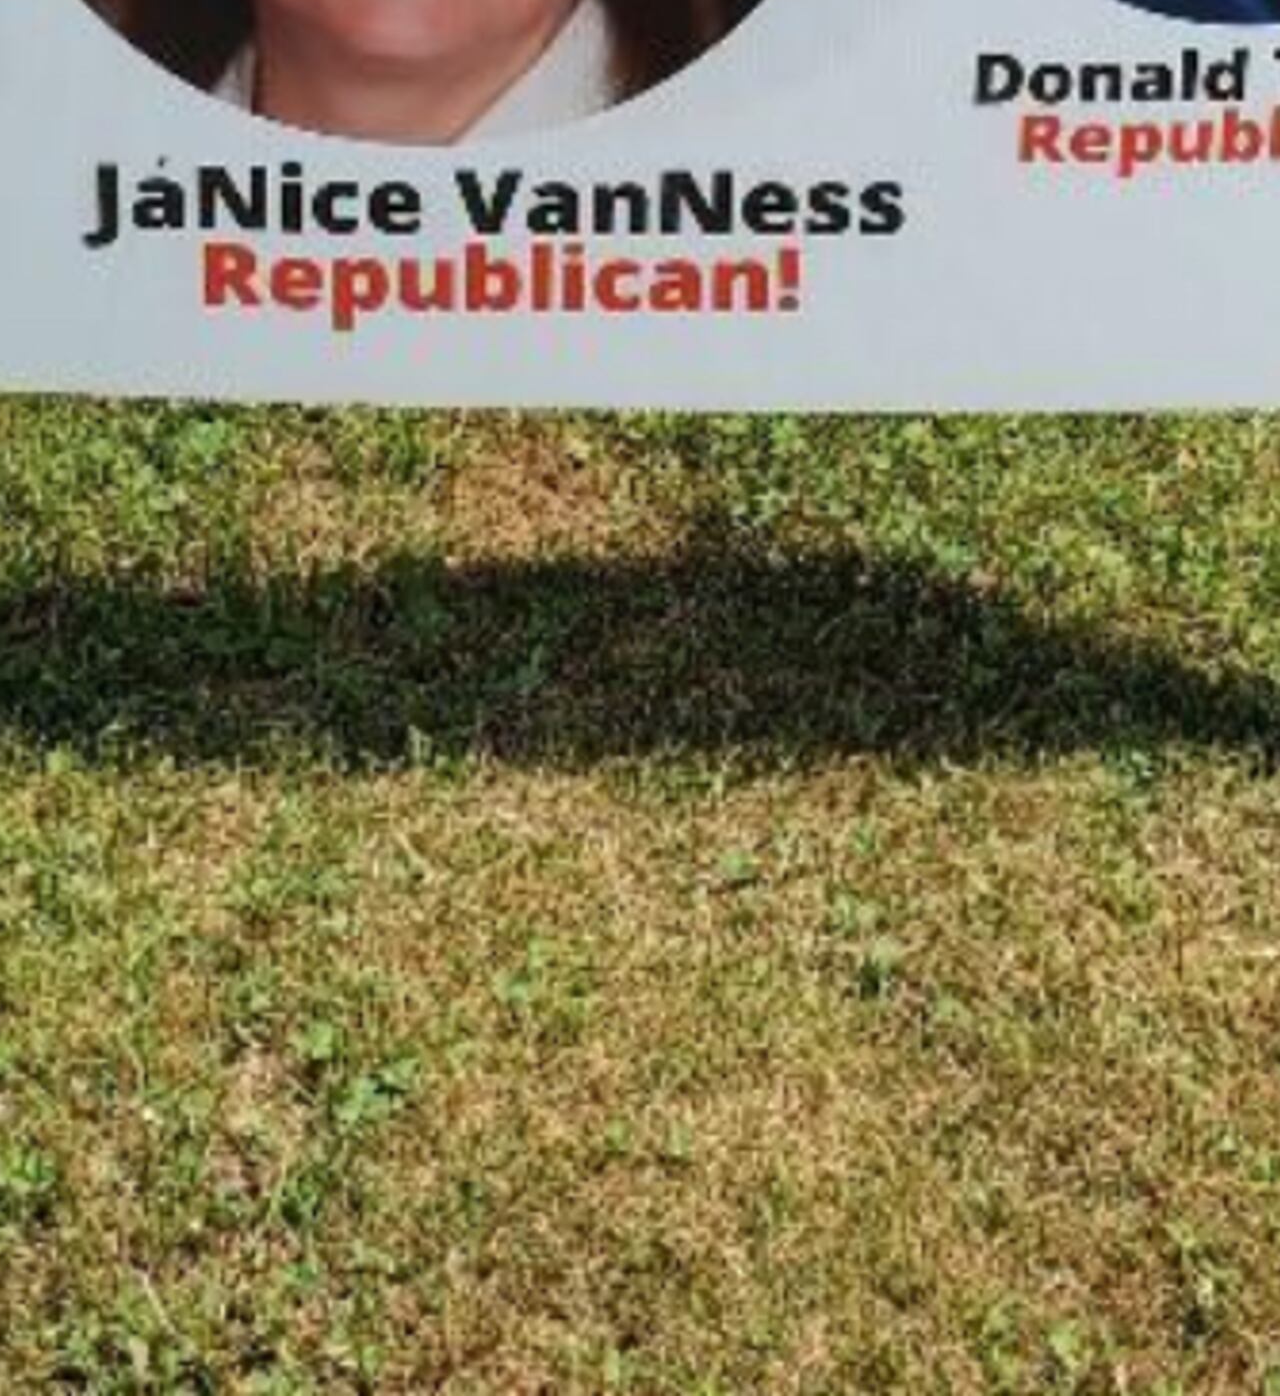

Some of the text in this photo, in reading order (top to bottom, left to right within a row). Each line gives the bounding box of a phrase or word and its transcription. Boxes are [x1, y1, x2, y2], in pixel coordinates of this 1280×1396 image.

[974, 48, 1249, 105] Donald
[83, 160, 907, 249] JaNice VanNess
[202, 241, 803, 330] Republican!
